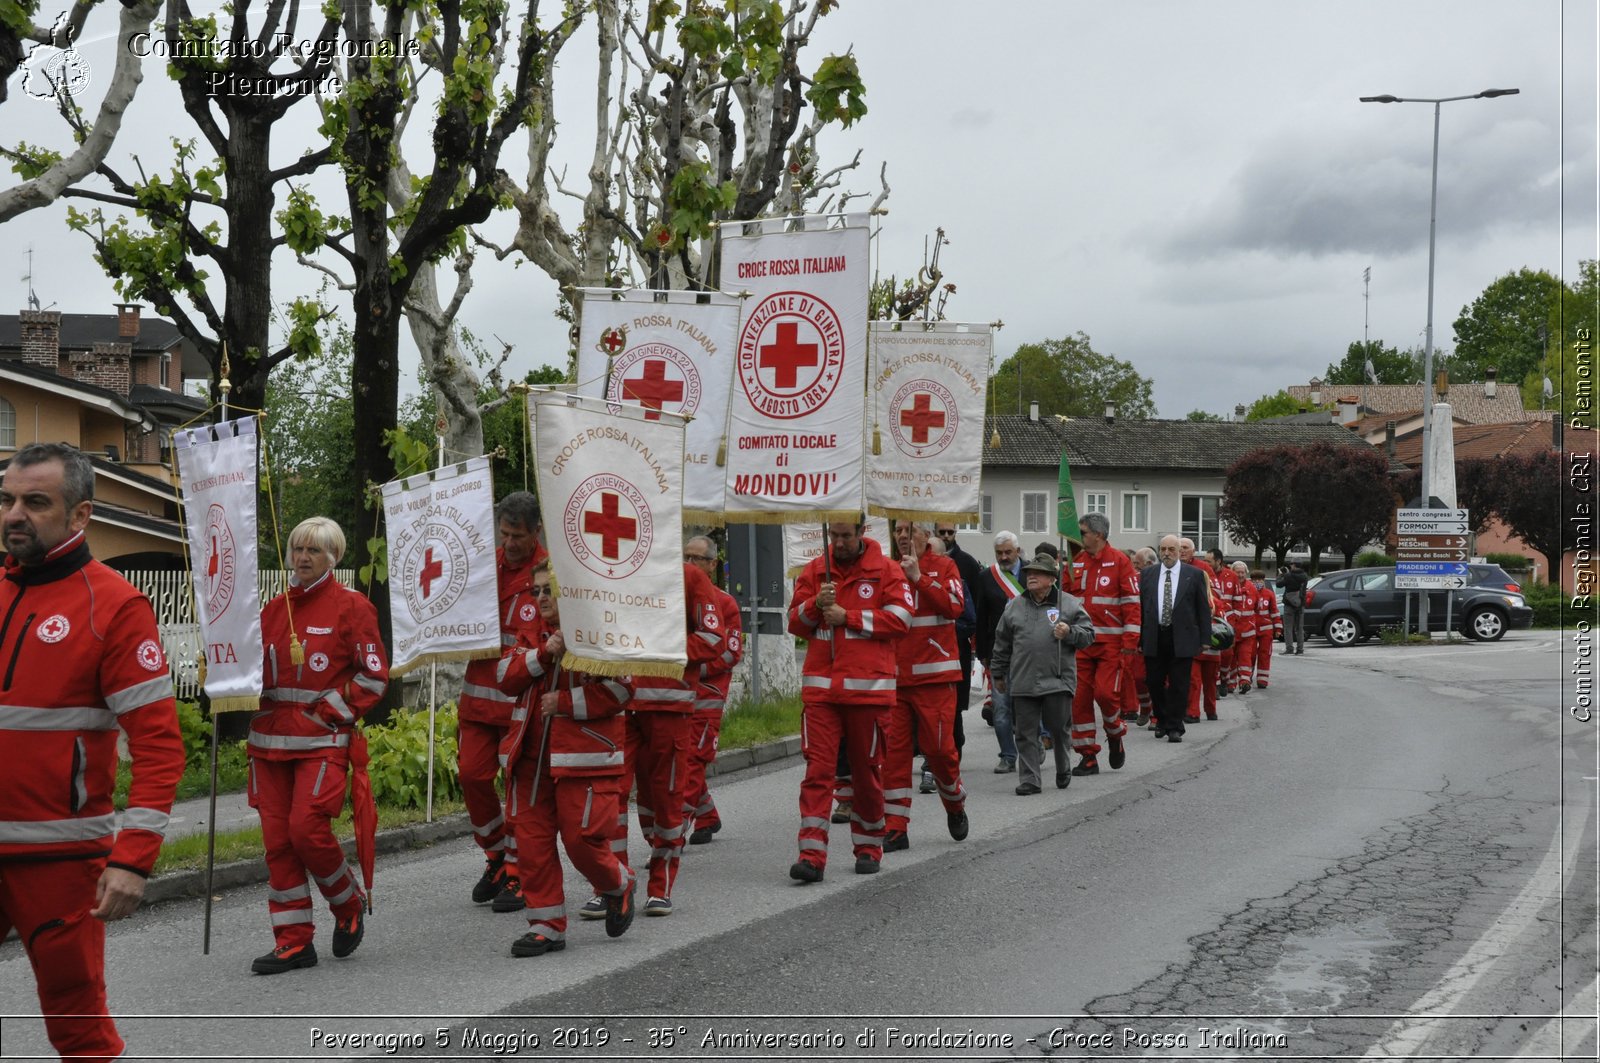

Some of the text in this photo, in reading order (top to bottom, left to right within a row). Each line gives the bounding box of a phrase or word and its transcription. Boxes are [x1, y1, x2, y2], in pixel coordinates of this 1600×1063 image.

[738, 255, 846, 279] CROCE ROSSA ITALIANA
[634, 315, 672, 329] ROSSA
[676, 319, 718, 357] ITALIANA
[743, 297, 840, 370] CONVENZIONE DI GINEVRA
[947, 339, 986, 347] SOCCORSO
[627, 352, 637, 362] DI
[638, 346, 678, 360] GINEVRA
[678, 357, 690, 369] 22
[687, 368, 699, 407] AGOSTO
[903, 352, 942, 365] ROSSA
[944, 357, 982, 394] ITALIANA
[750, 384, 828, 415] 22 AGOSTO 1864
[902, 387, 909, 395] DI
[909, 381, 941, 394] GINEVRA
[941, 391, 950, 400] 22
[947, 400, 957, 433] AGOSTO
[738, 434, 837, 450] COMITATO LOCALE
[551, 426, 669, 495] CROCE ROSSA ITALIANA
[685, 453, 708, 464] ALE
[776, 453, 788, 467] di
[734, 473, 837, 496] MONDOVI'
[871, 470, 972, 484] COMITATO LOCALE DI
[436, 489, 449, 501] DEL
[903, 486, 934, 498] BRA
[567, 477, 651, 568] CONVENZIONE DI GINEVRA 22 AGOSTO 1864
[390, 505, 487, 578] CROCE ROSA ITALIANA
[448, 538, 460, 552] 22
[219, 547, 234, 600] AGOSTO
[450, 554, 466, 594] AGOSTO
[429, 594, 454, 615] 1864
[619, 592, 666, 609] LOCALE
[604, 610, 617, 624] DI
[424, 622, 486, 639] CARAGLIO
[575, 629, 645, 649] BUSCA
